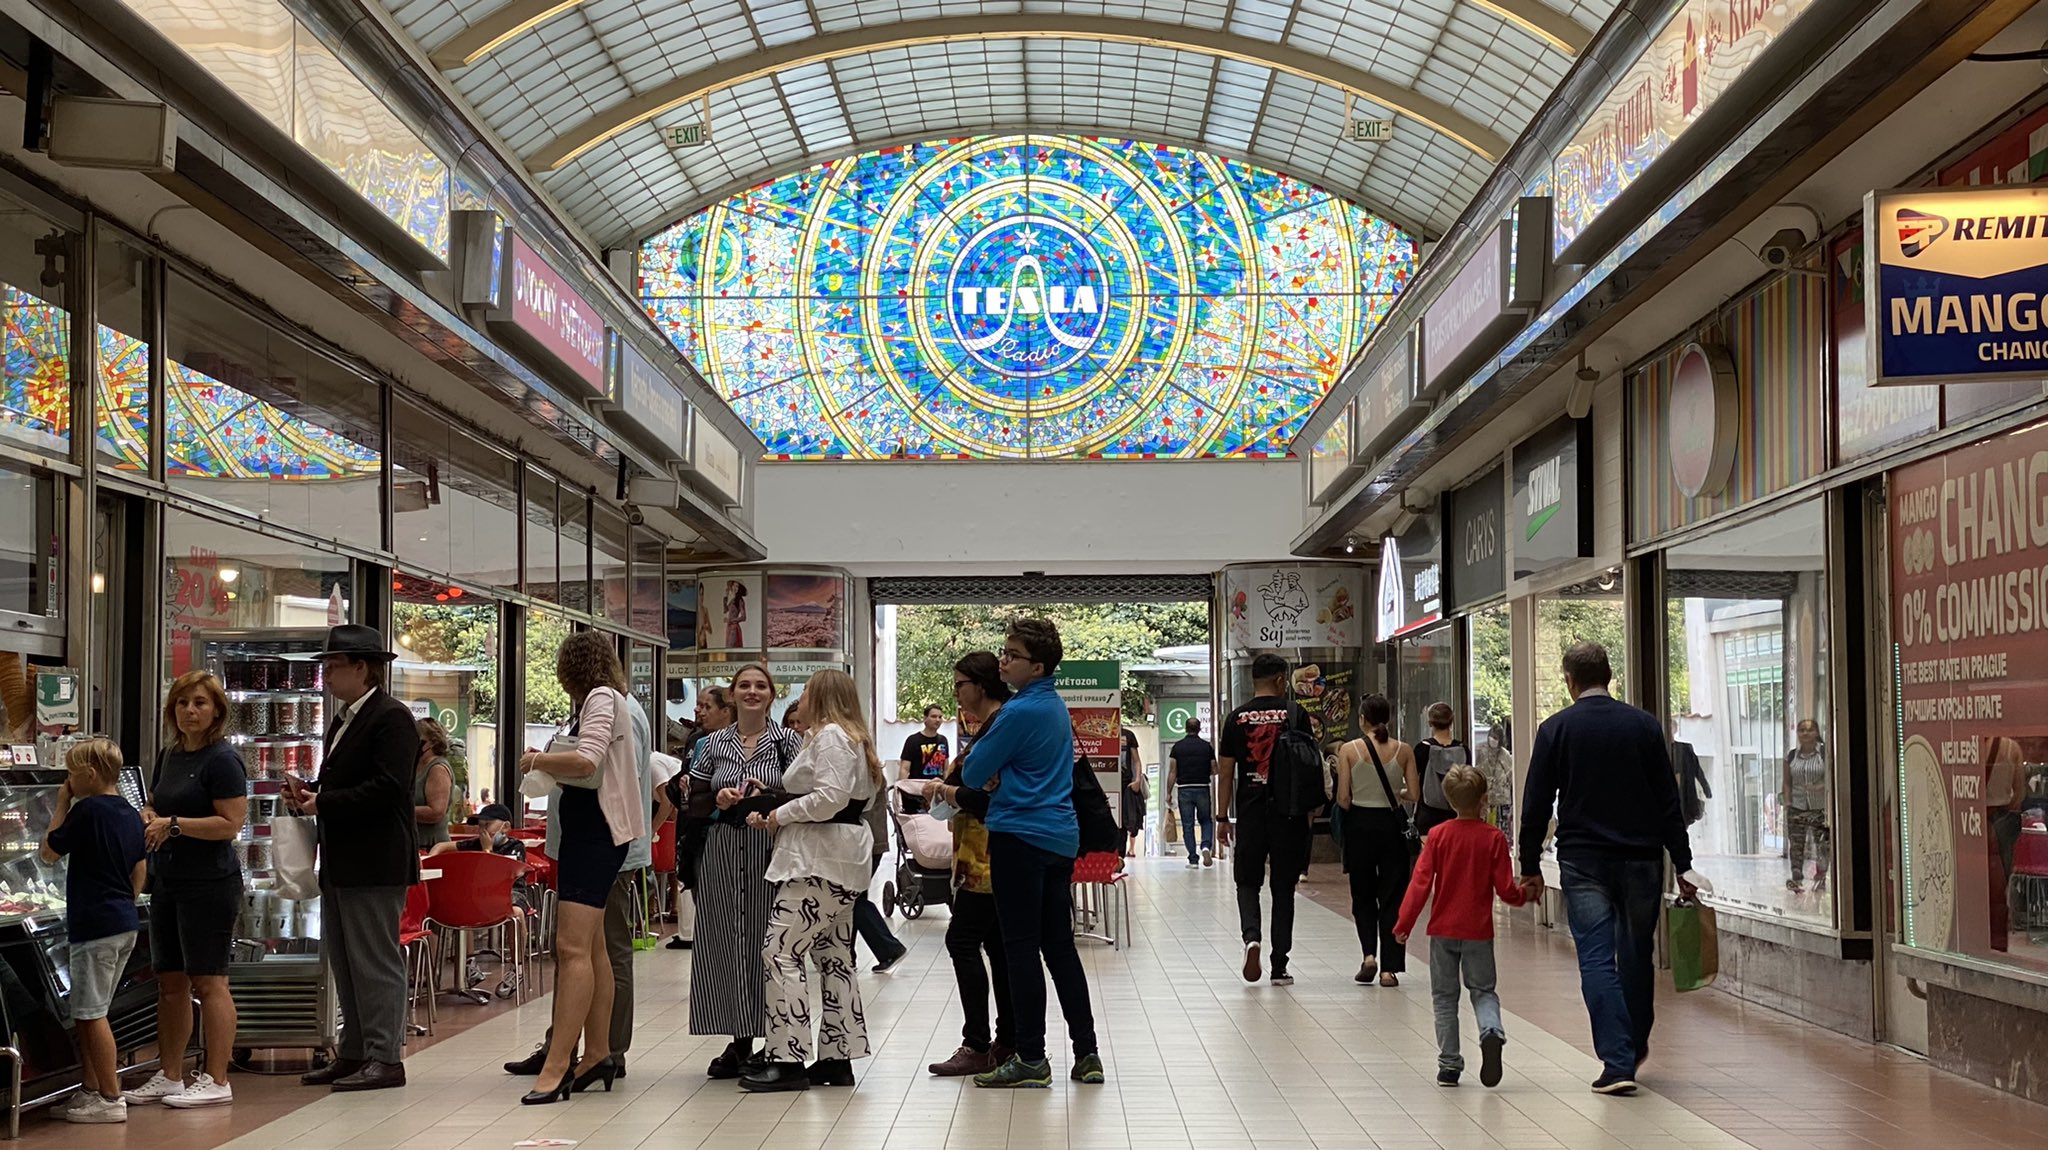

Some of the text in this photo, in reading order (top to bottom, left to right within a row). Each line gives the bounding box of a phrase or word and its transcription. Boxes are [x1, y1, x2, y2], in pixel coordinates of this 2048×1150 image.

[675, 126, 700, 144] EXIT
[1357, 121, 1382, 137] EXIT
[958, 286, 1098, 315] TESLA
[1891, 293, 2048, 336] MANG
[992, 337, 1063, 363] Radio
[1899, 485, 1938, 527] MANGO
[1940, 450, 2048, 566] CHANG
[1465, 508, 1496, 567] CARYS
[1902, 588, 1932, 647] 0%
[1260, 624, 1283, 648] Saj
[712, 665, 739, 674] POTRAV
[776, 664, 803, 673] ASIAN
[1903, 652, 2007, 685] THE BEST RATE IN PRAGUE
[1904, 694, 2003, 722] ЛУЧШИЕ КУРСЫ В ПРАГЕ
[1941, 735, 1980, 765] NEJLEPŠÍ
[1952, 774, 1980, 800] KURZY
[1961, 806, 1982, 837] V ČR
